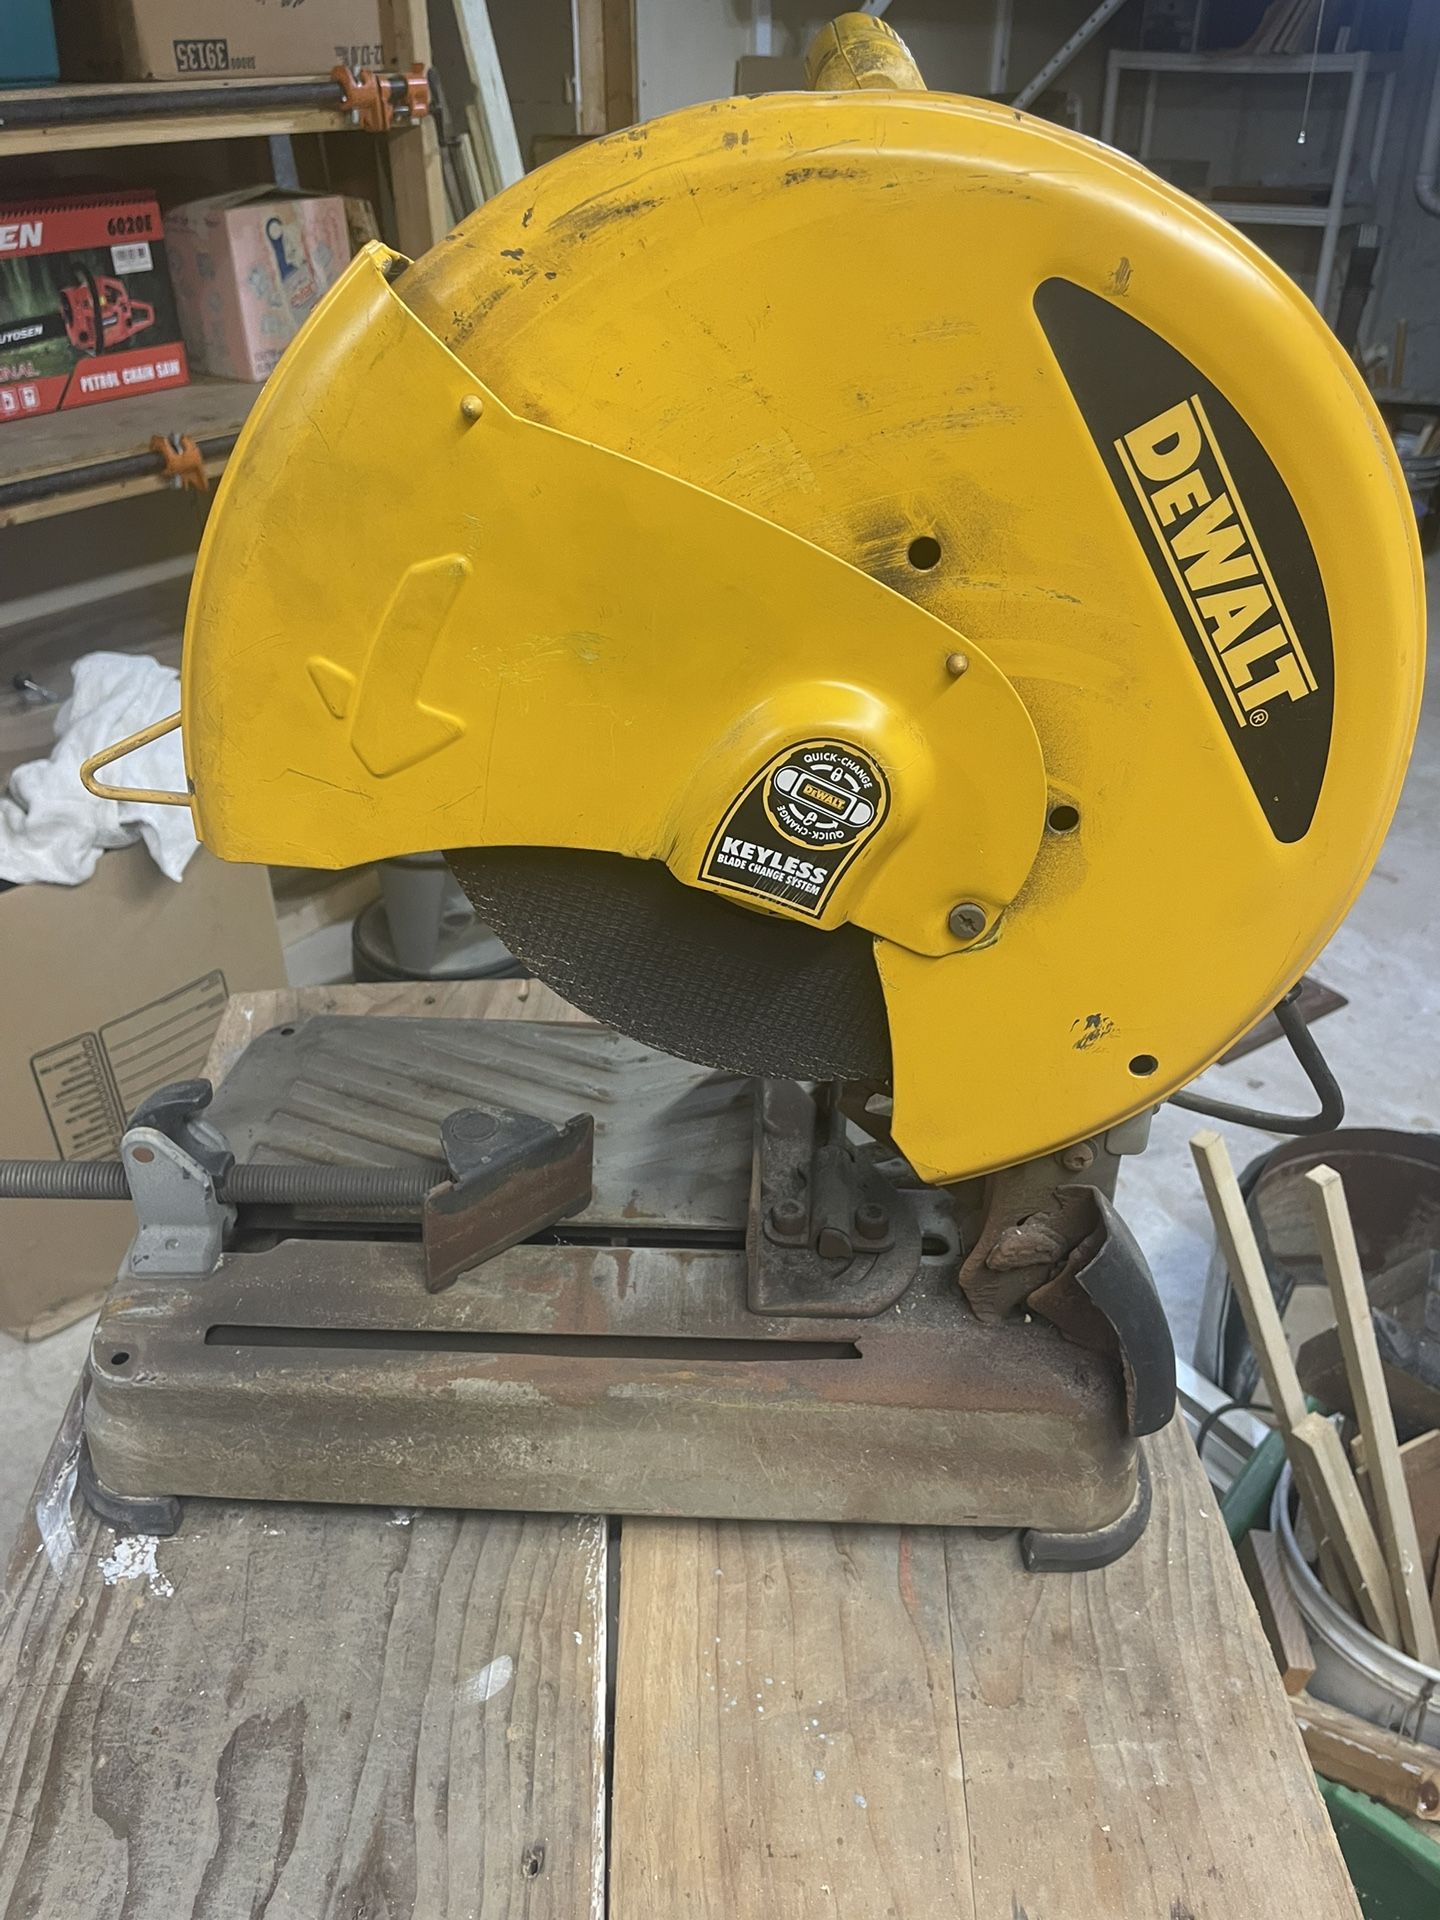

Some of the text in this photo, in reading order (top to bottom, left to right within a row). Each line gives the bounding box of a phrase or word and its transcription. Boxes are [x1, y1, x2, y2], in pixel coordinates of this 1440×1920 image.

[175, 41, 229, 71] 39135
[107, 215, 153, 236] 6020E
[80, 359, 181, 393] PETROL CHAIN SAW
[803, 752, 873, 790] QUICK-CHANGE
[802, 783, 847, 810] DEWALT
[776, 805, 845, 840] QUICK-CHANGE
[716, 853, 821, 896] BLADE CHANGE SYSTEM
[720, 836, 829, 885] KEYLESS
